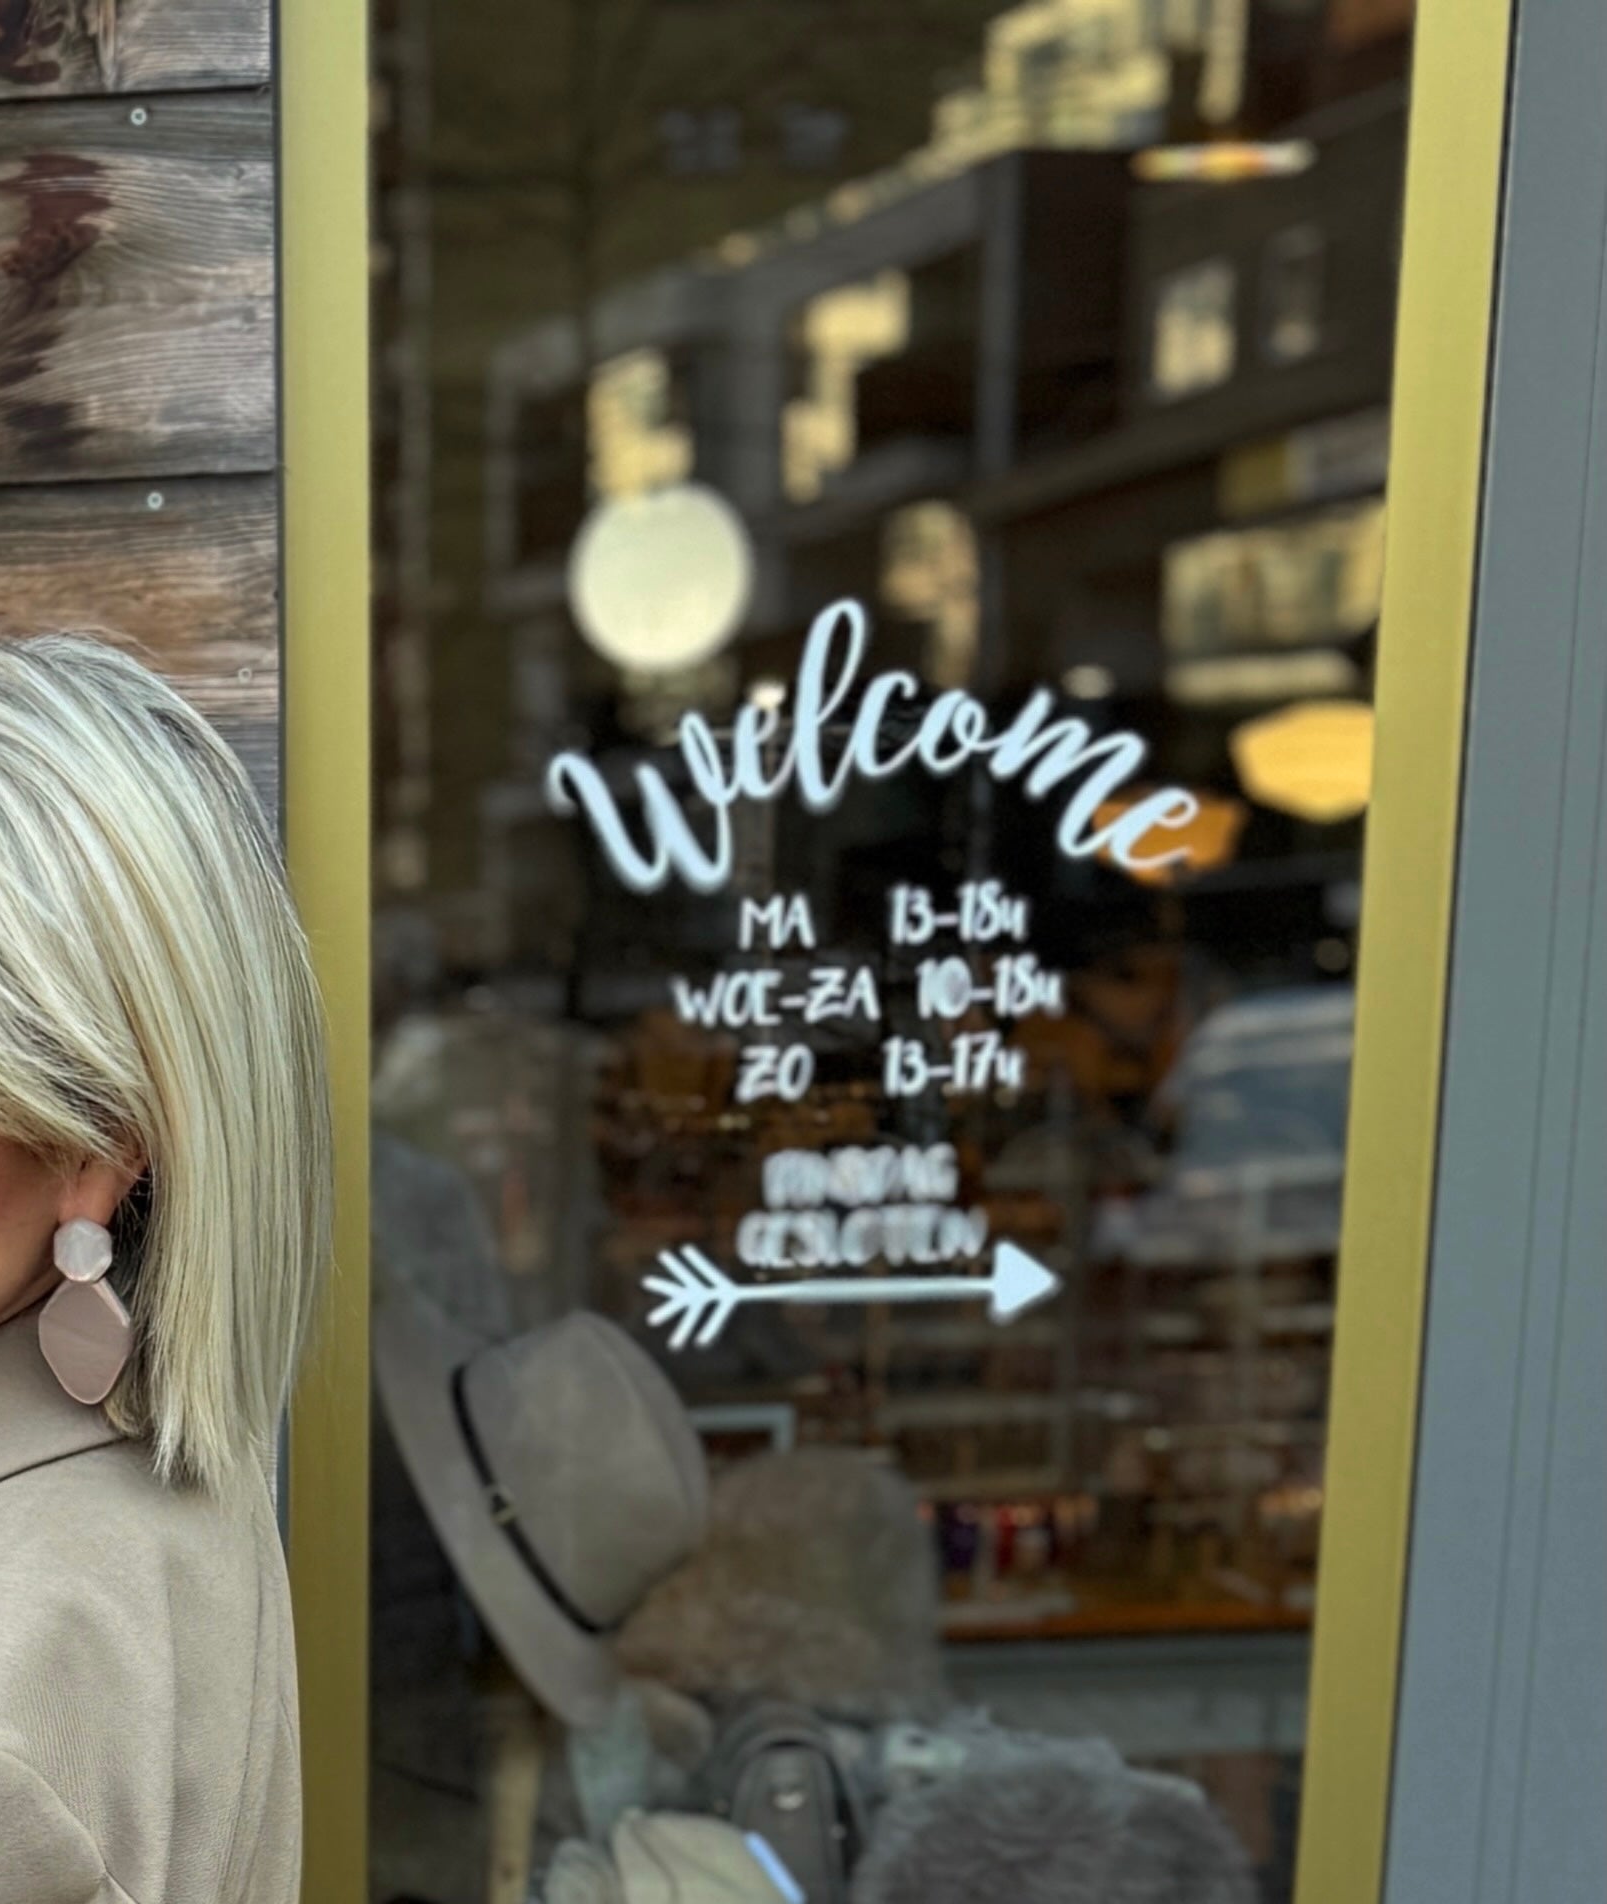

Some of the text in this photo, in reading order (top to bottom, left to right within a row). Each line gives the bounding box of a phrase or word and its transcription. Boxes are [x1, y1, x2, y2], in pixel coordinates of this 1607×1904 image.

[547, 598, 1199, 892] Welcome
[739, 879, 1030, 951] MA 13-18u
[669, 964, 881, 1028] WOE-ZA
[735, 1030, 1026, 1104] ZO 13-17u
